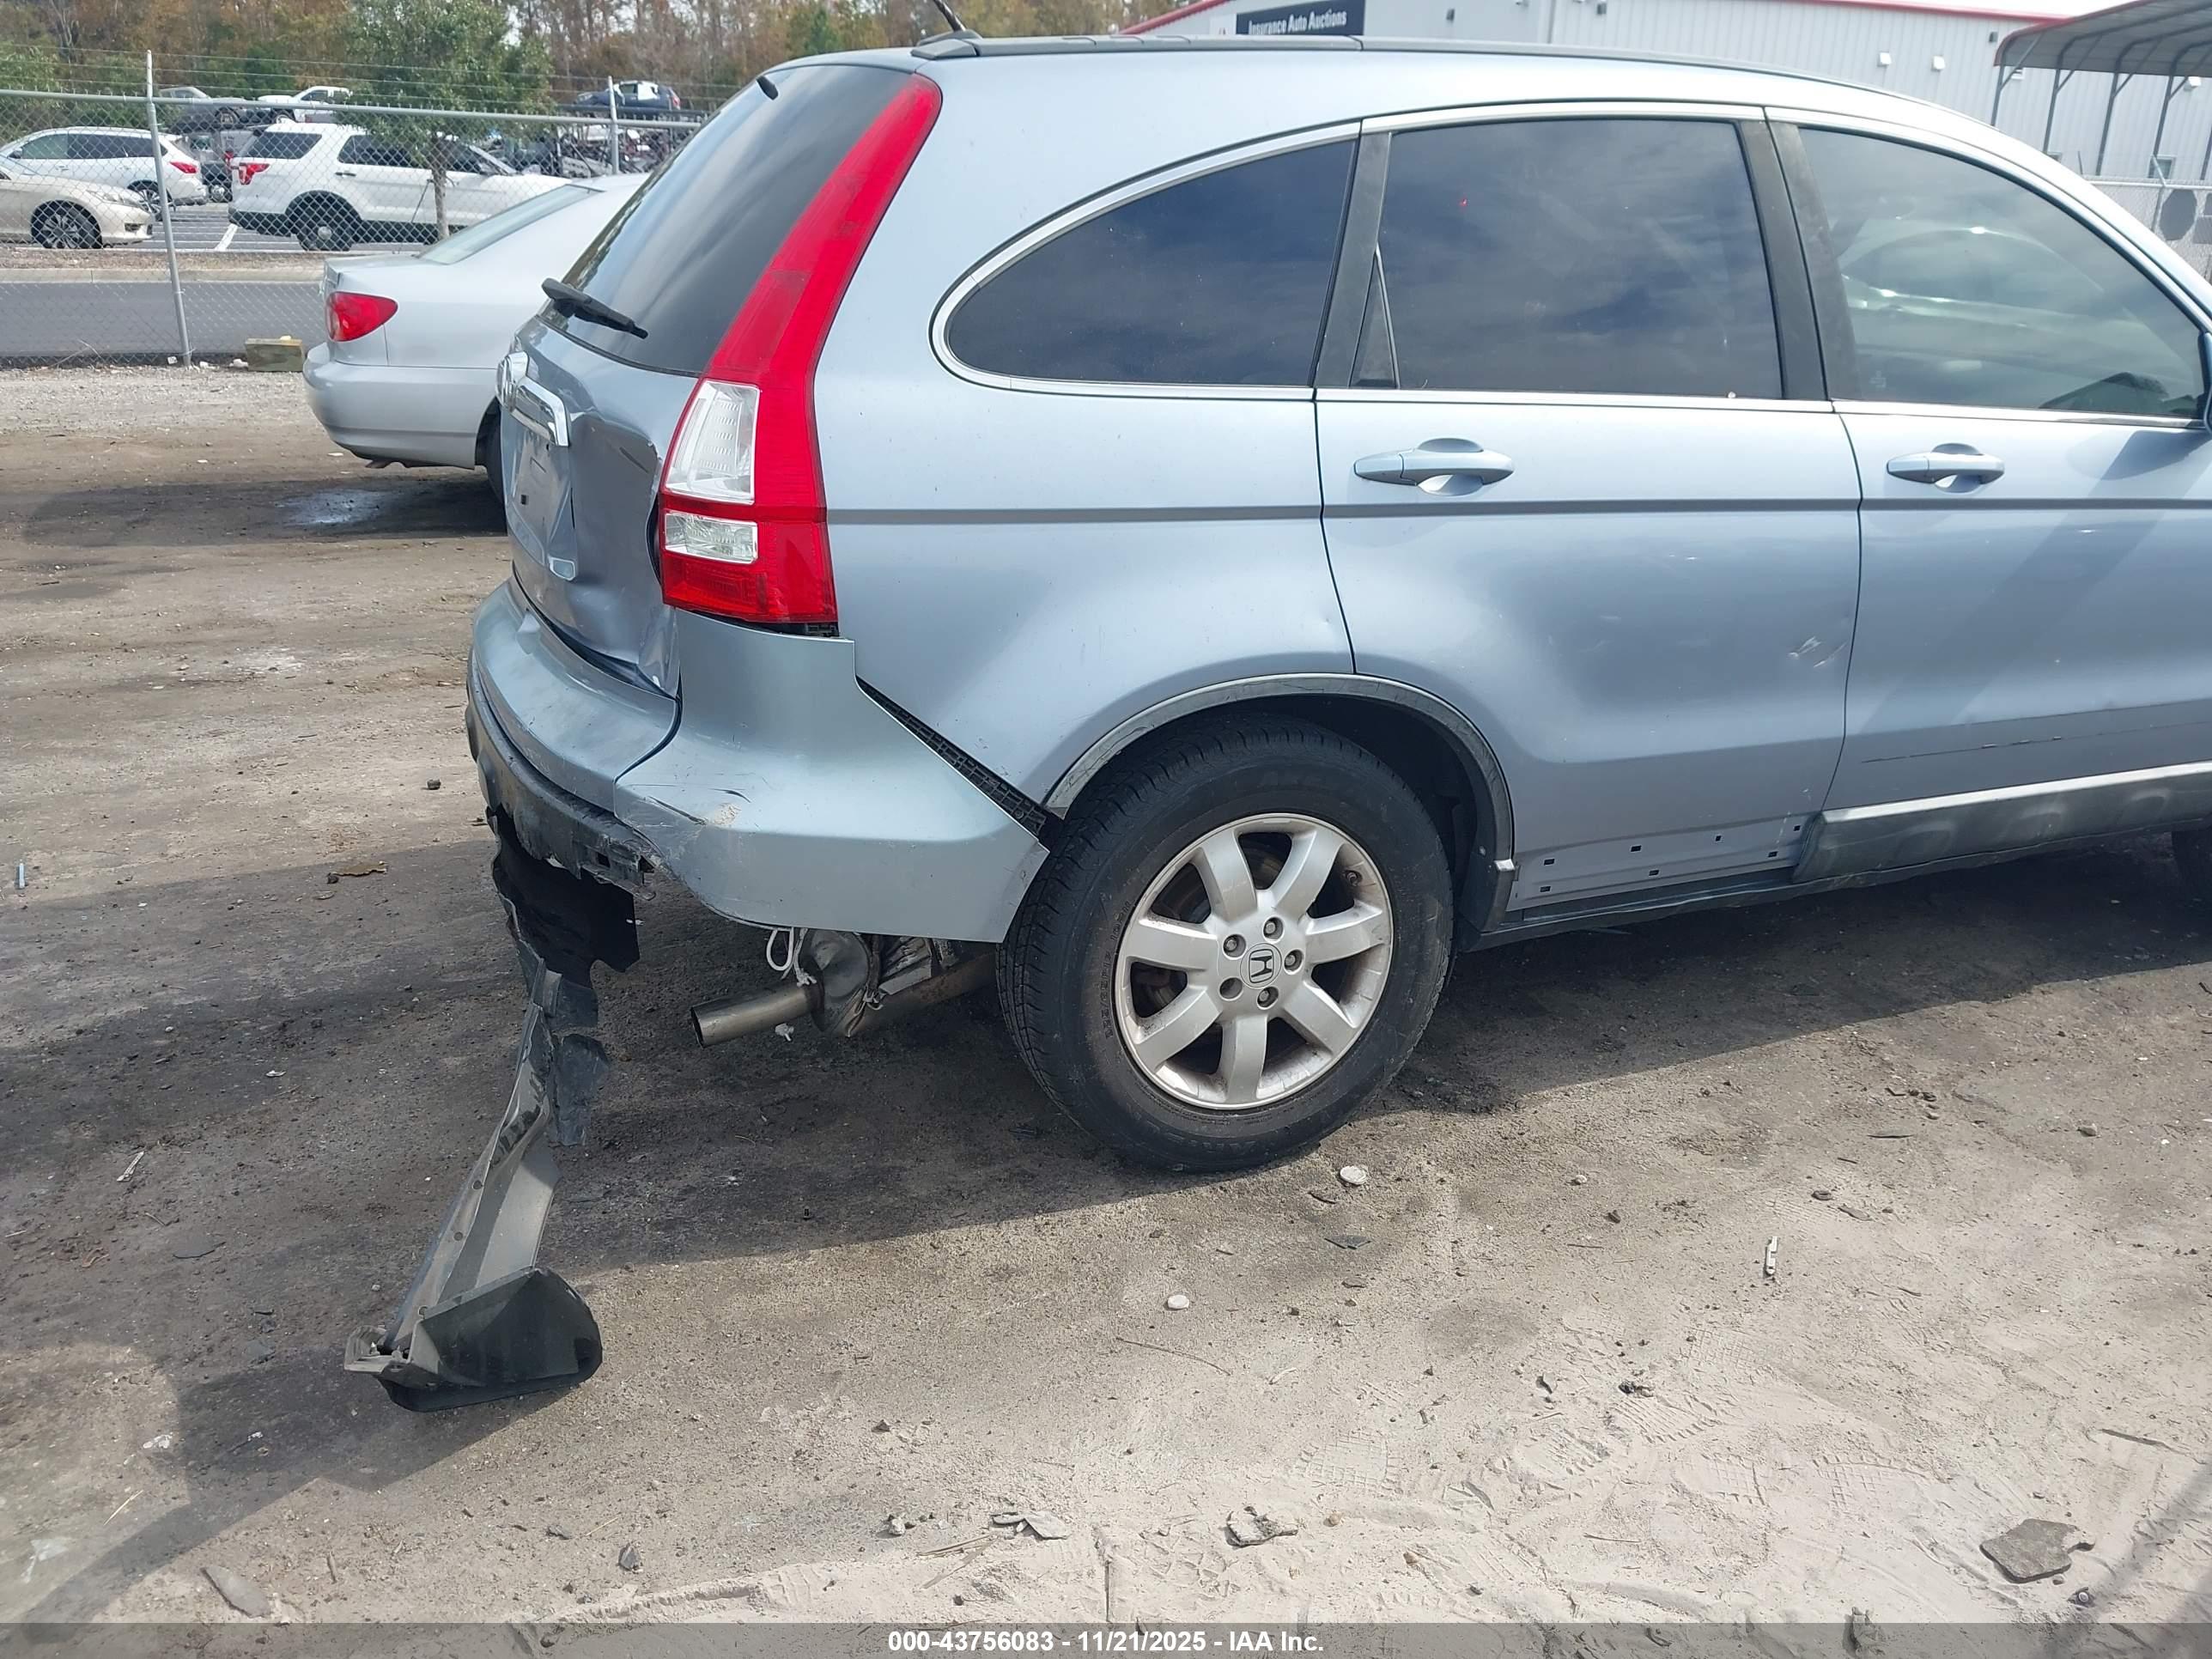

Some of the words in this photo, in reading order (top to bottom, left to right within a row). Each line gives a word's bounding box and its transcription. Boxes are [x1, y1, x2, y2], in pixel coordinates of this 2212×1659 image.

[1249, 20, 1287, 35] Insurance
[1288, 14, 1308, 33] Auto
[1308, 9, 1347, 30] Auctions
